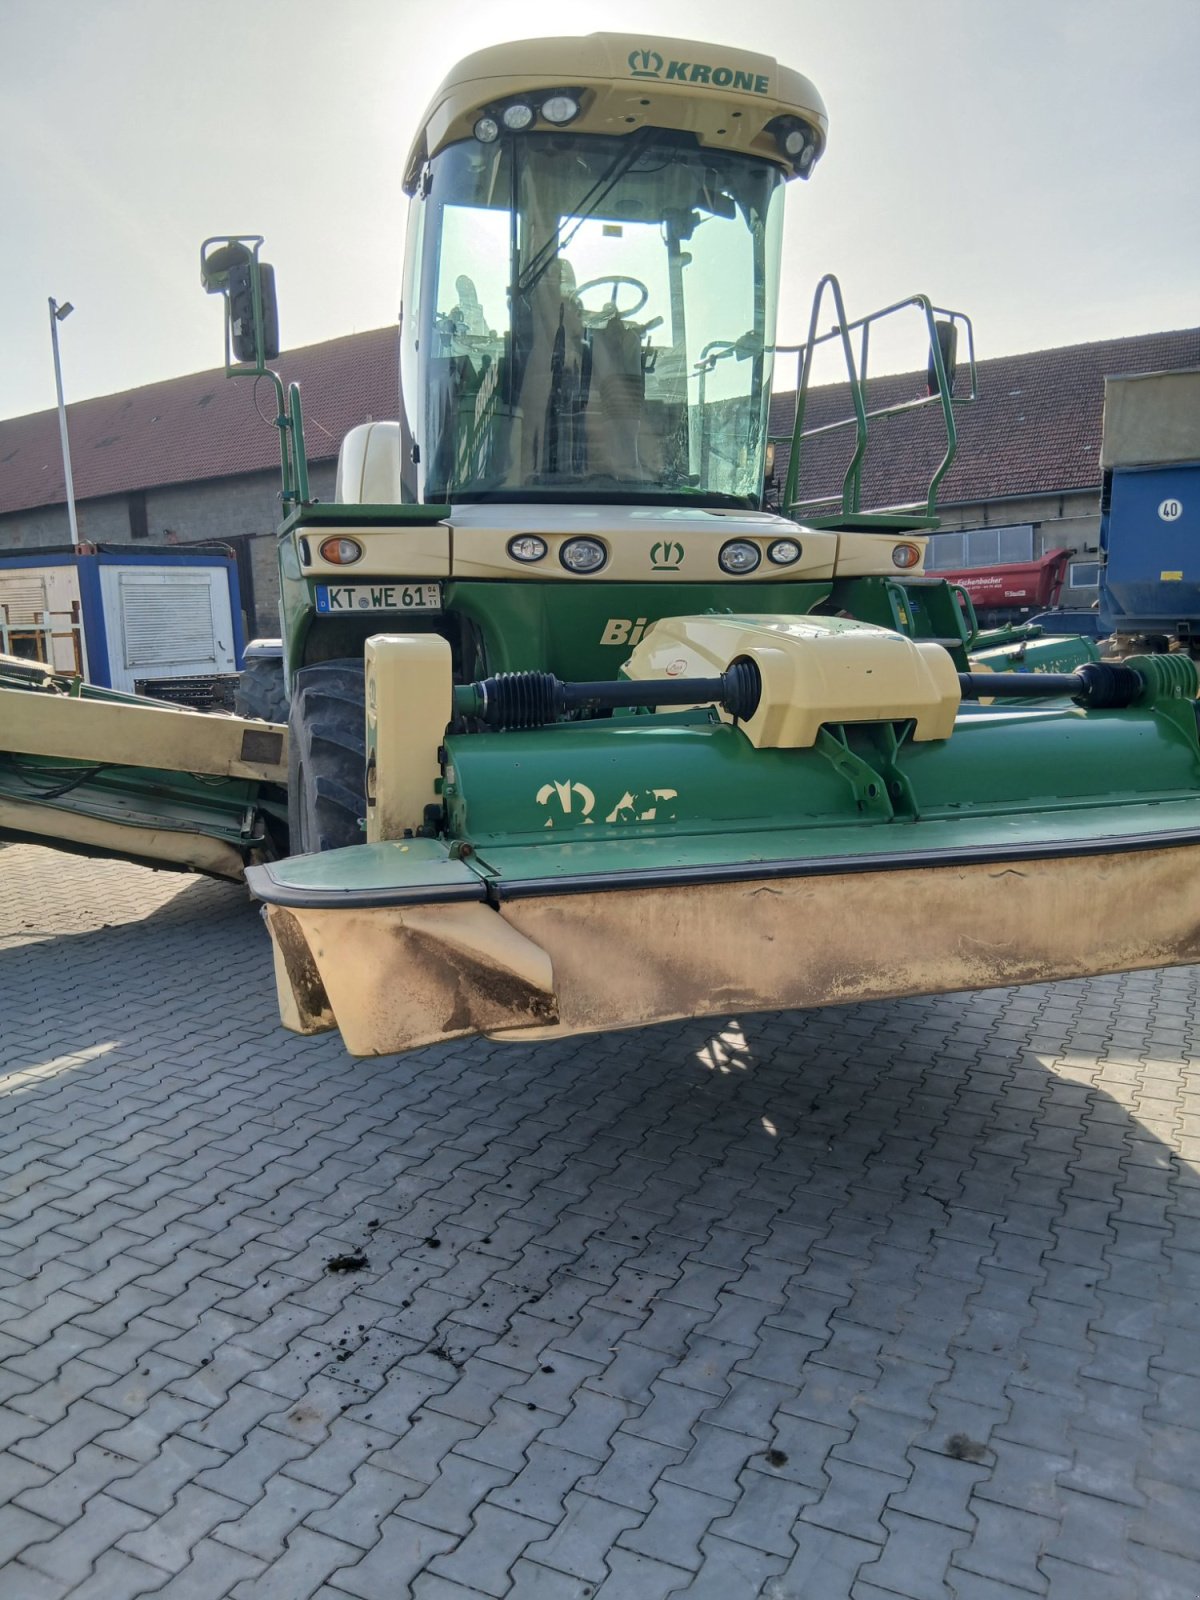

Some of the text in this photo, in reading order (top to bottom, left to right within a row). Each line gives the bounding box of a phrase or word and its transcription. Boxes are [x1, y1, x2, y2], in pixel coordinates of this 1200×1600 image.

[666, 61, 769, 94] KRONE
[1163, 502, 1178, 517] 40
[329, 588, 355, 608] KT
